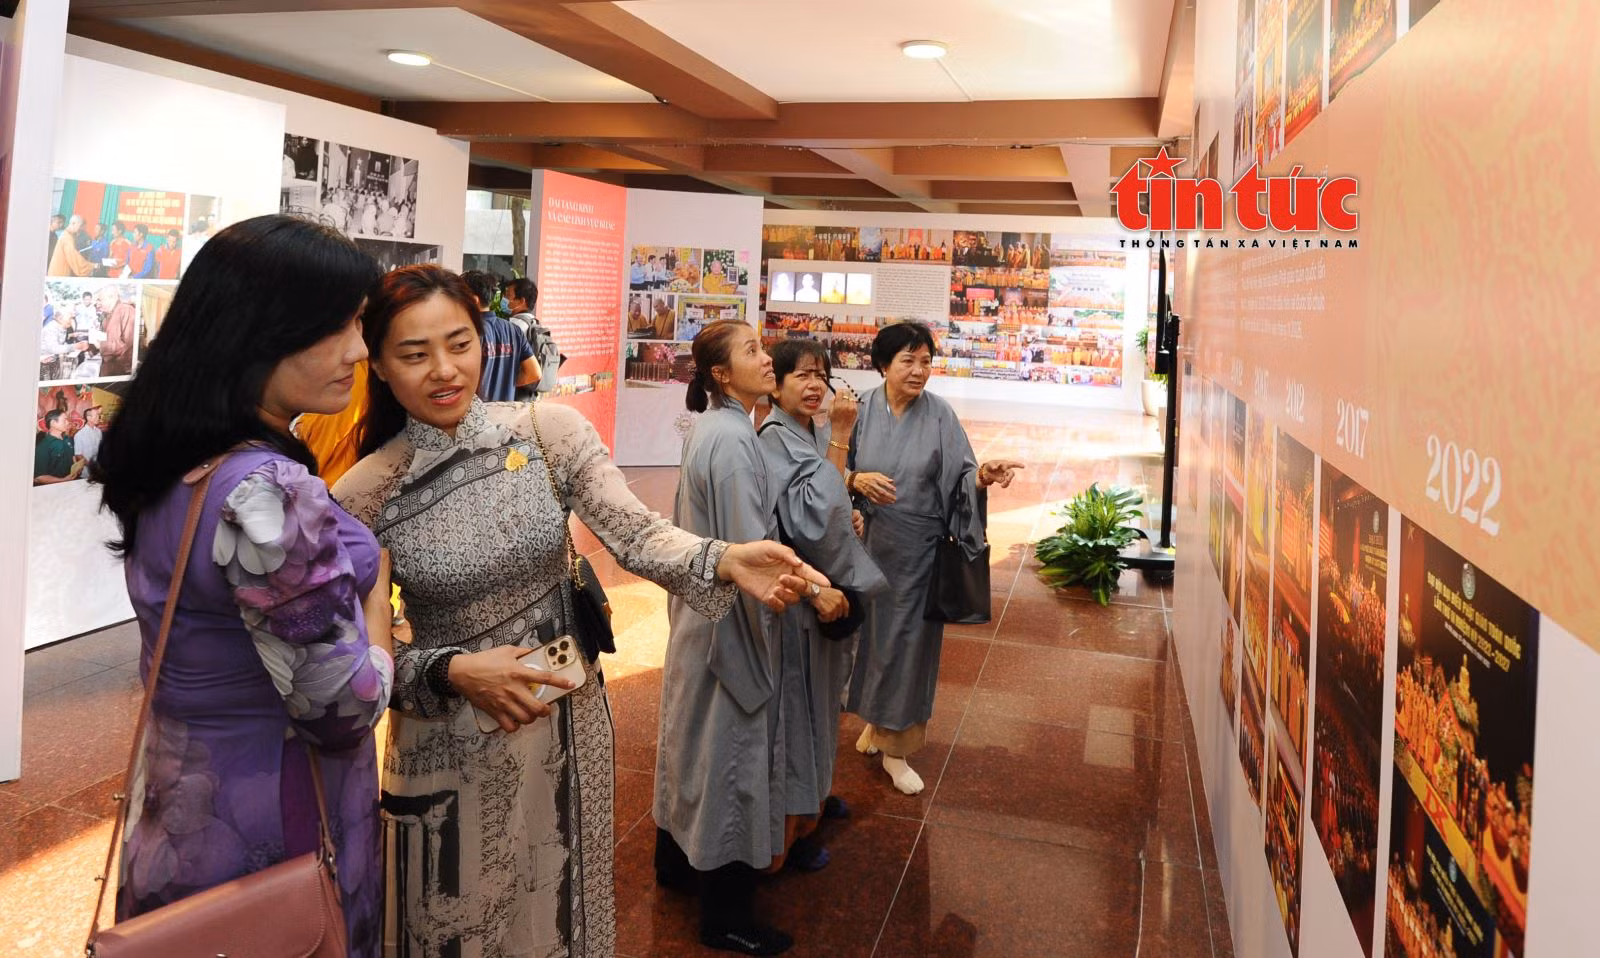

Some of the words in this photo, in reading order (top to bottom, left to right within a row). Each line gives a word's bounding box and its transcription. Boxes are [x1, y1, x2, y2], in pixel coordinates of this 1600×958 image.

[1286, 379, 1305, 423] 2012
[1336, 398, 1369, 459] 2017
[1425, 434, 1502, 537] 2022
